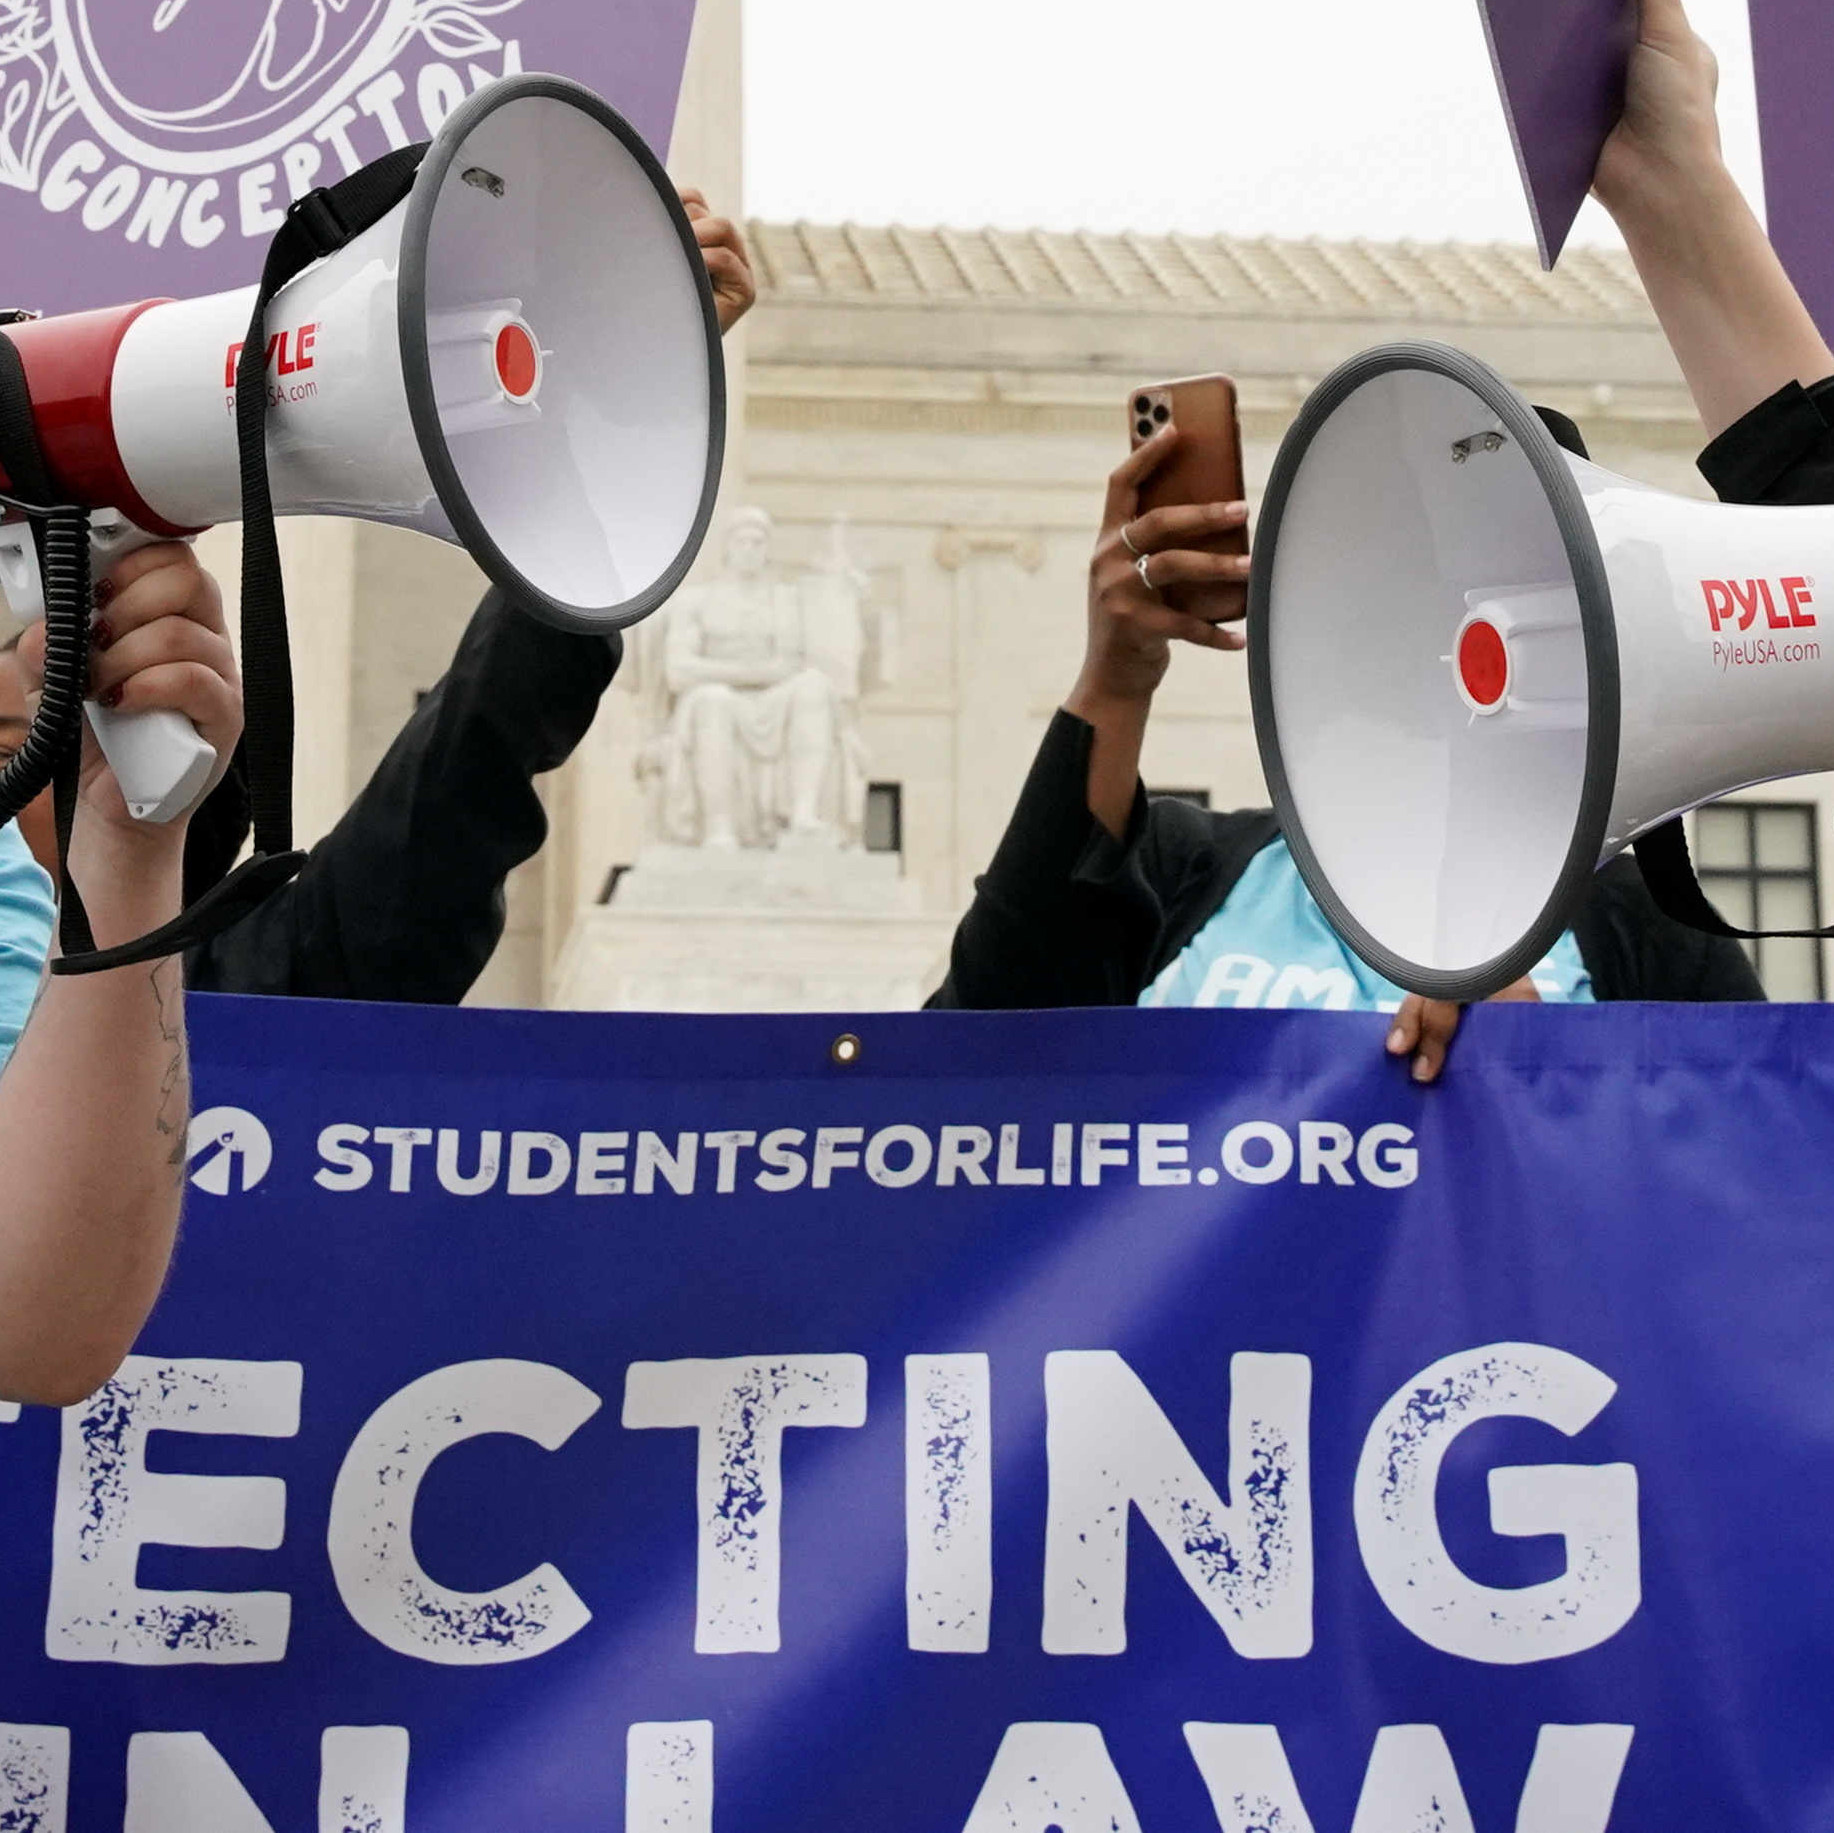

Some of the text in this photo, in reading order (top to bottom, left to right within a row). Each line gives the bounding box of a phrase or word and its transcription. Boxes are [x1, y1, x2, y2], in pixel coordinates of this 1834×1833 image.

[225, 380, 319, 417] PSA.com
[1700, 576, 1817, 631] PYLE
[1712, 638, 1821, 673] PyleUSA.com
[313, 1119, 1420, 1197] STUDENTSFORLIFE.ORG
[47, 1340, 1642, 1666] ECTING
